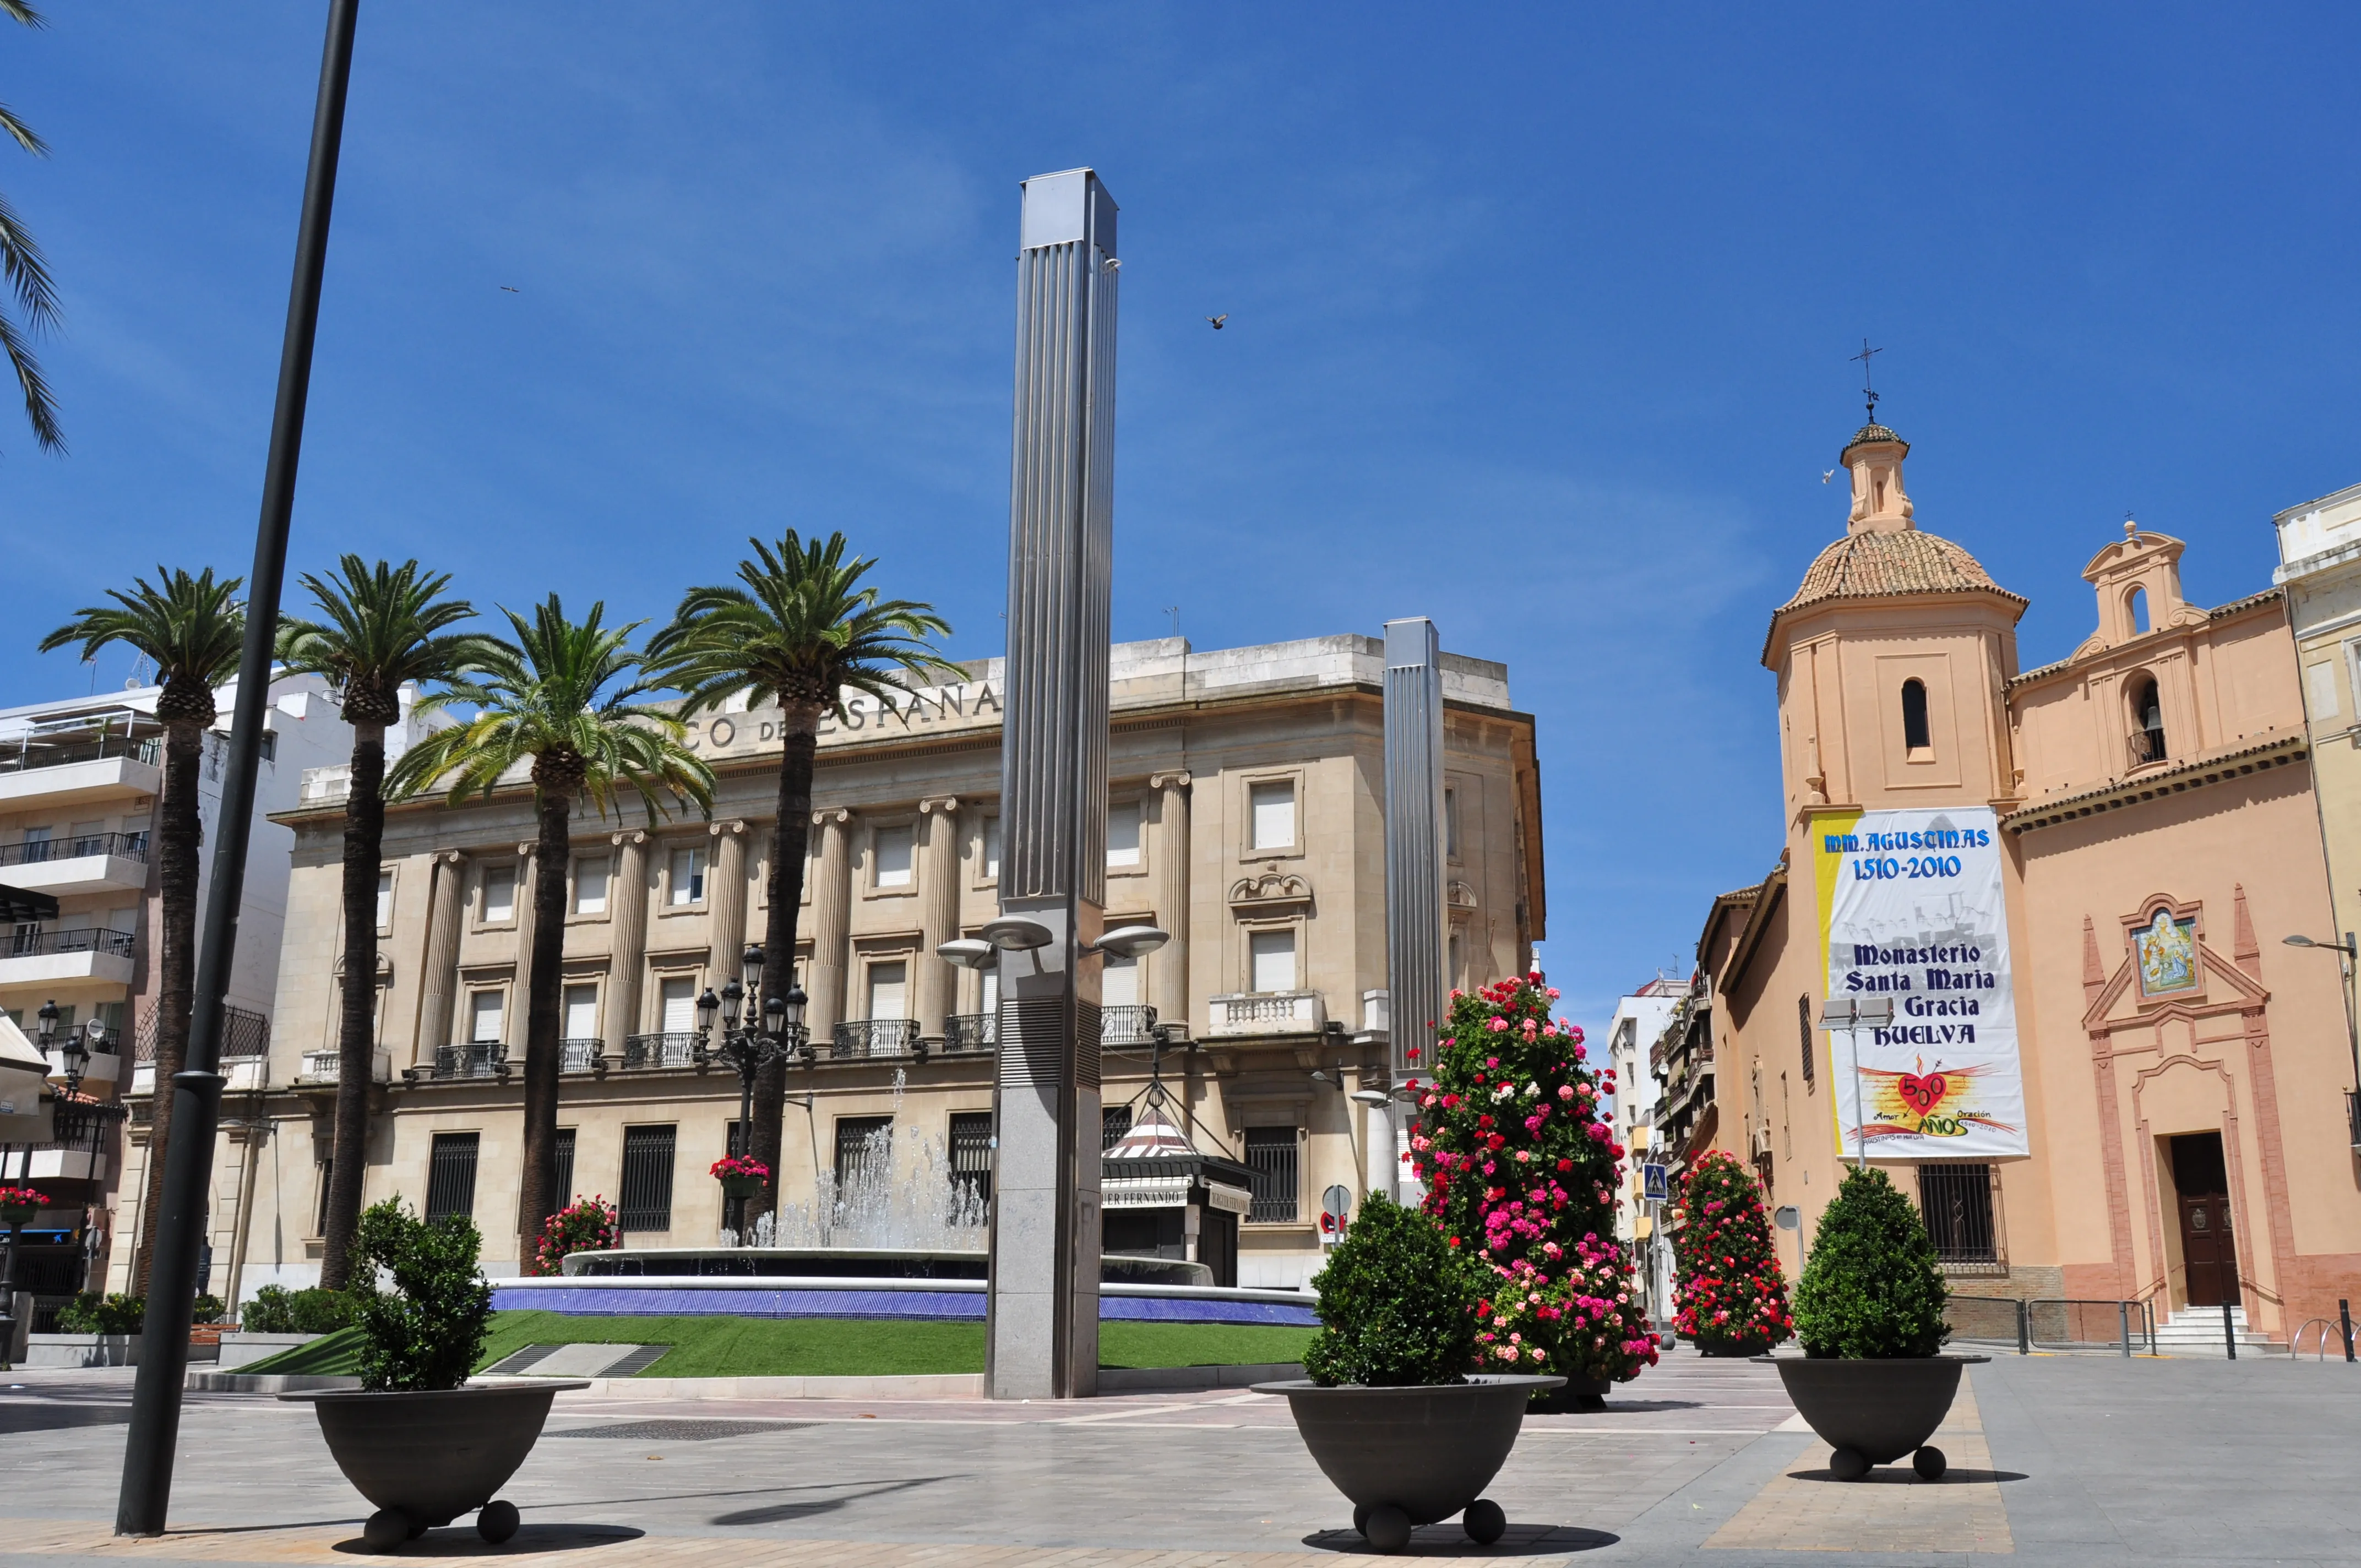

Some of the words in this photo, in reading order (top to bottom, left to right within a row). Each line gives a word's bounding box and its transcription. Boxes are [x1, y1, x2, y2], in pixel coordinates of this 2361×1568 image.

[815, 680, 1003, 736] ESPAÑA
[1853, 856, 1961, 880] 1510-2010
[1854, 944, 1981, 966] Monasterio
[1846, 971, 1911, 992] Santa
[1926, 968, 1995, 990] Maria
[1905, 995, 1980, 1016] Gracia
[1873, 1112, 1899, 1120] Amor
[1916, 1114, 1968, 1136] AÑOS
[1960, 1121, 1996, 1133] 1510-2010
[1863, 1134, 1896, 1145] AGUSTINAS
[1101, 1193, 1120, 1205] UER
[1124, 1191, 1179, 1205] FERNANDO
